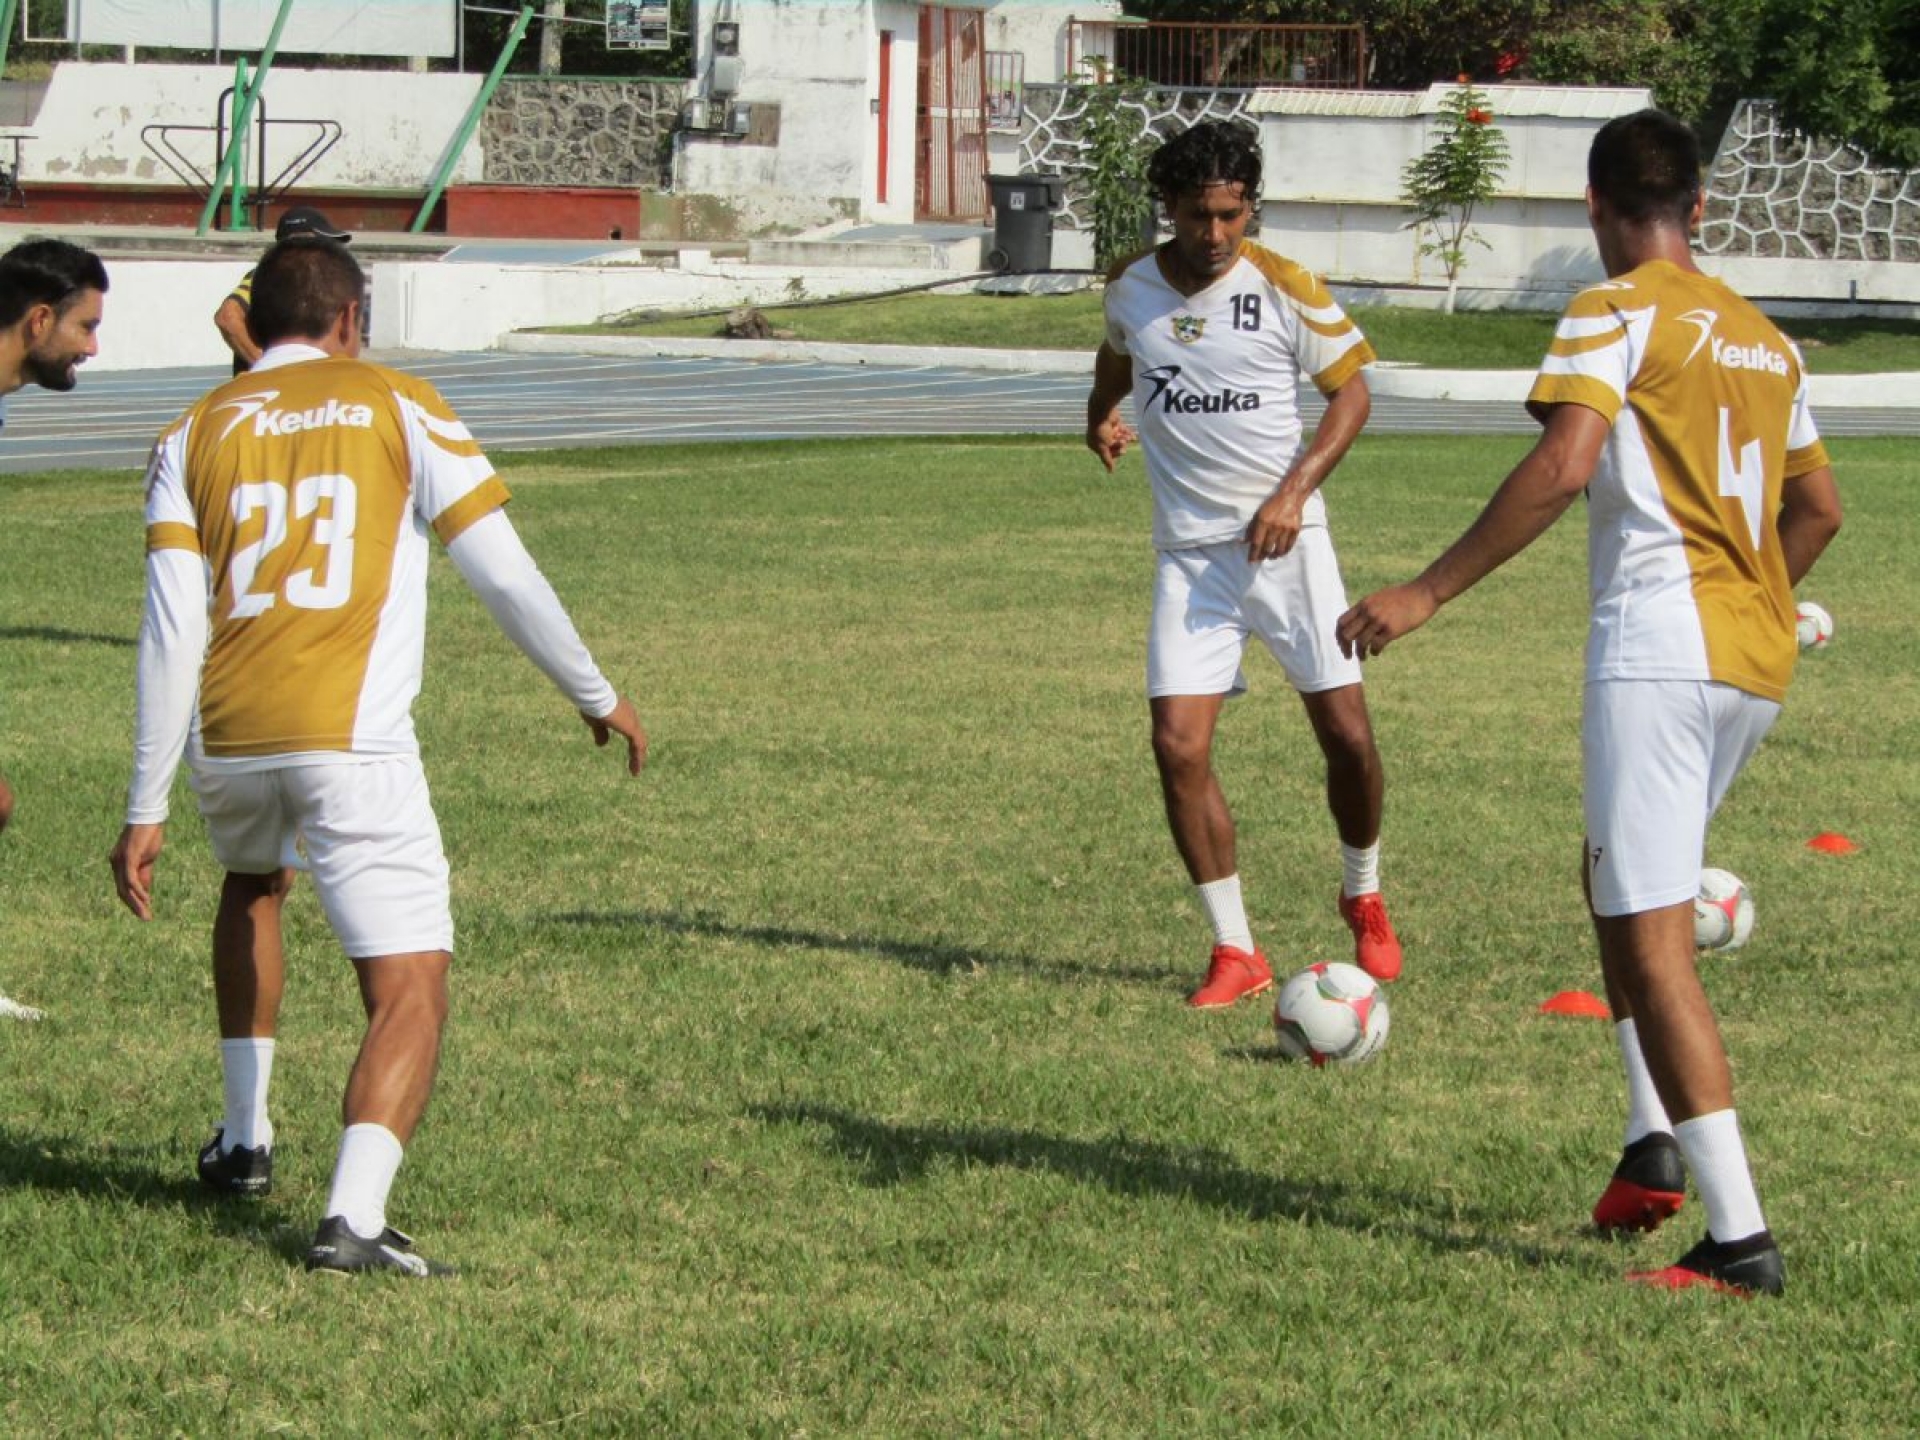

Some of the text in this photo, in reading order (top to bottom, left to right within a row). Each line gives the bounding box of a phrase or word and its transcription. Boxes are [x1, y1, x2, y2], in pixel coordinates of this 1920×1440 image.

[1229, 293, 1262, 332] 19
[1711, 335, 1789, 377] Keuka
[255, 399, 374, 437] Keuka
[1163, 388, 1260, 414] Keuka
[1718, 407, 1764, 552] 4
[228, 474, 358, 619] 23
